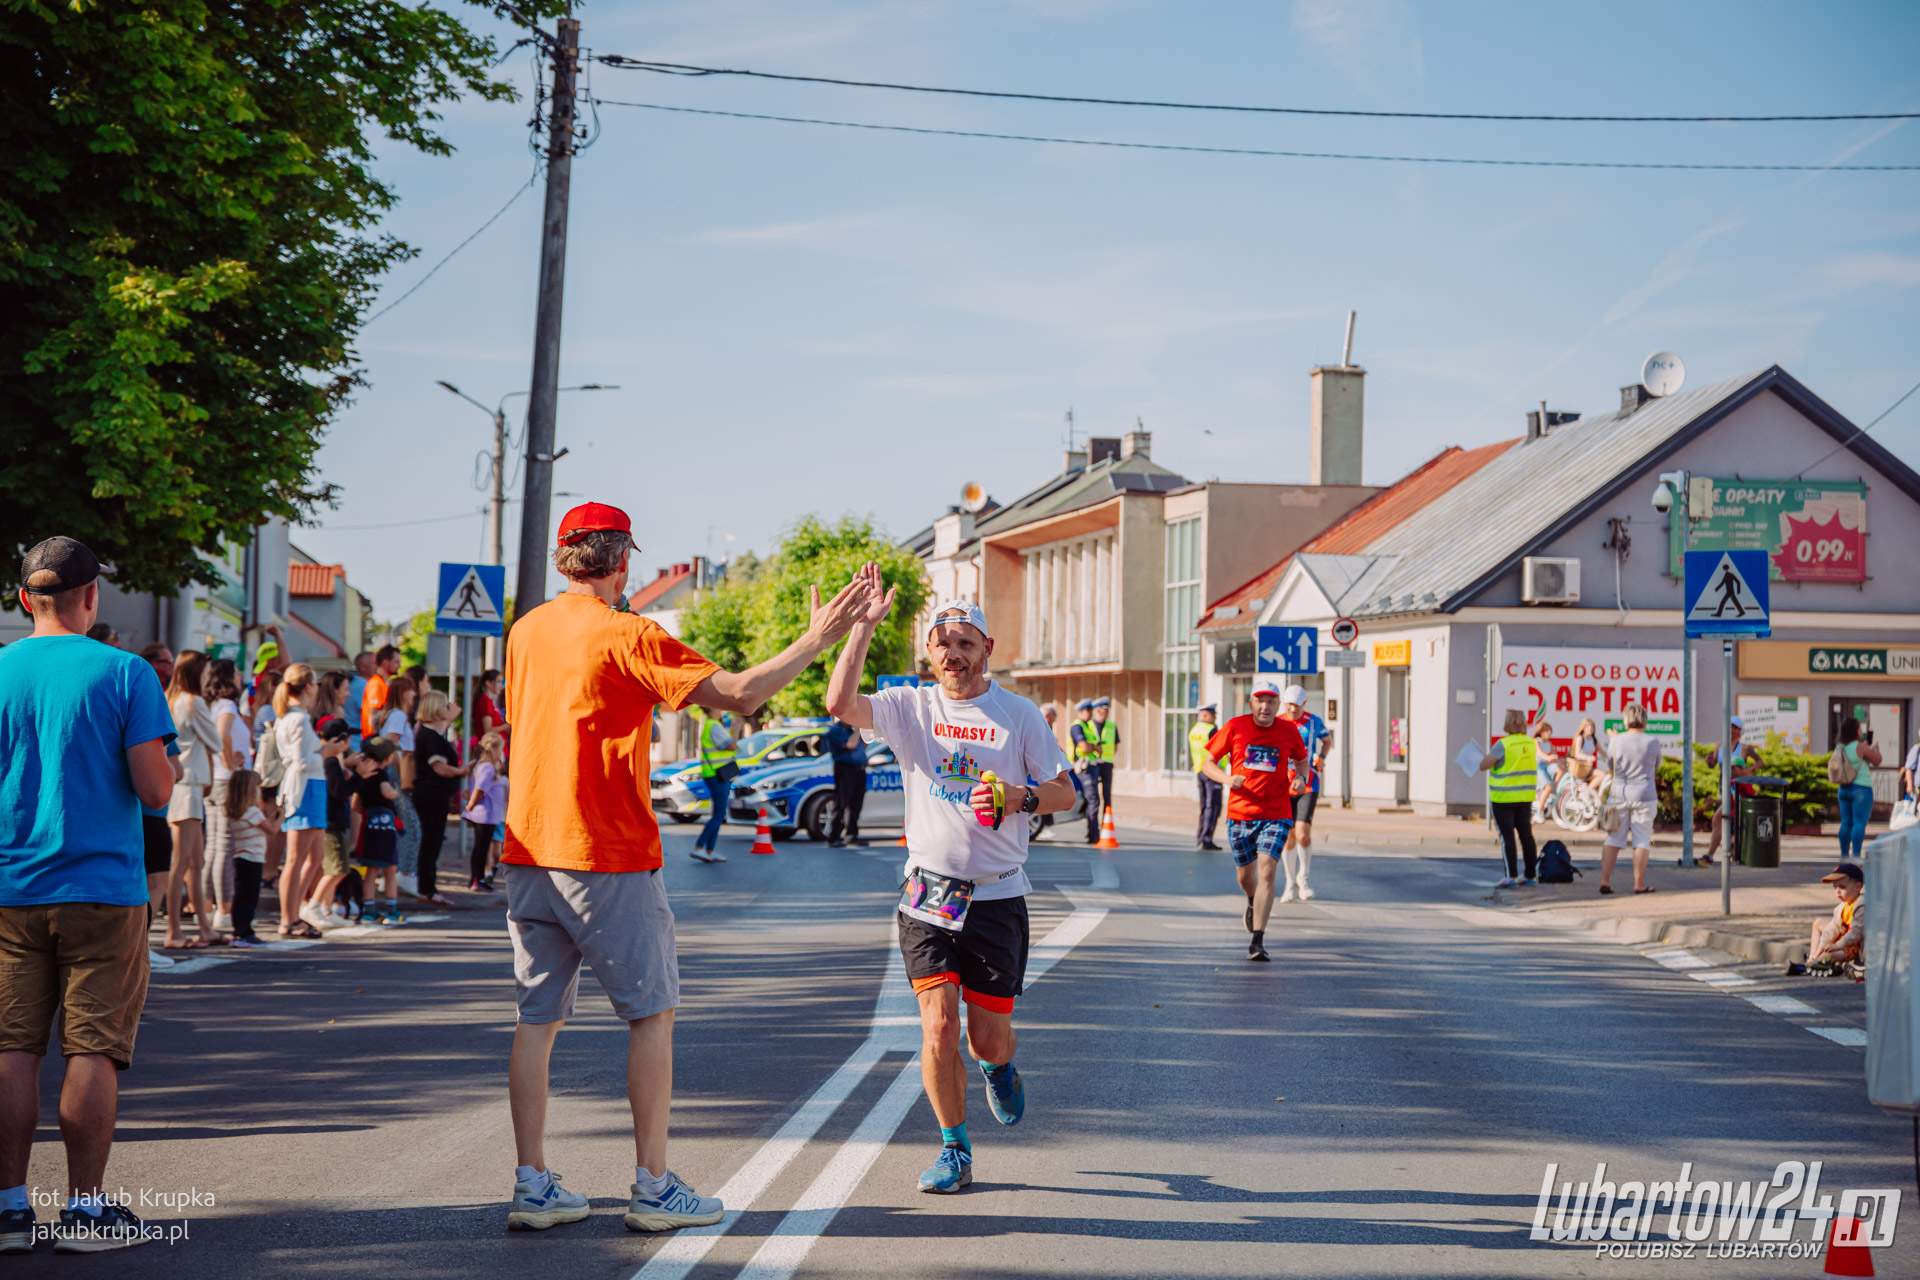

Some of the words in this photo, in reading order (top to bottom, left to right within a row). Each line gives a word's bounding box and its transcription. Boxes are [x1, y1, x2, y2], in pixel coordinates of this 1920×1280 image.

[1726, 488, 1786, 505] OPŁATY
[1796, 539, 1844, 564] 0,99
[1506, 662, 1680, 681] CAŁODOBOWA
[1833, 654, 1882, 670] KASA
[1892, 655, 1920, 670] UNI
[1555, 685, 1680, 713] APTEKA
[934, 723, 987, 742] ULTRASY
[1254, 751, 1269, 762] 21
[871, 774, 902, 788] POLI
[927, 886, 943, 907] 2
